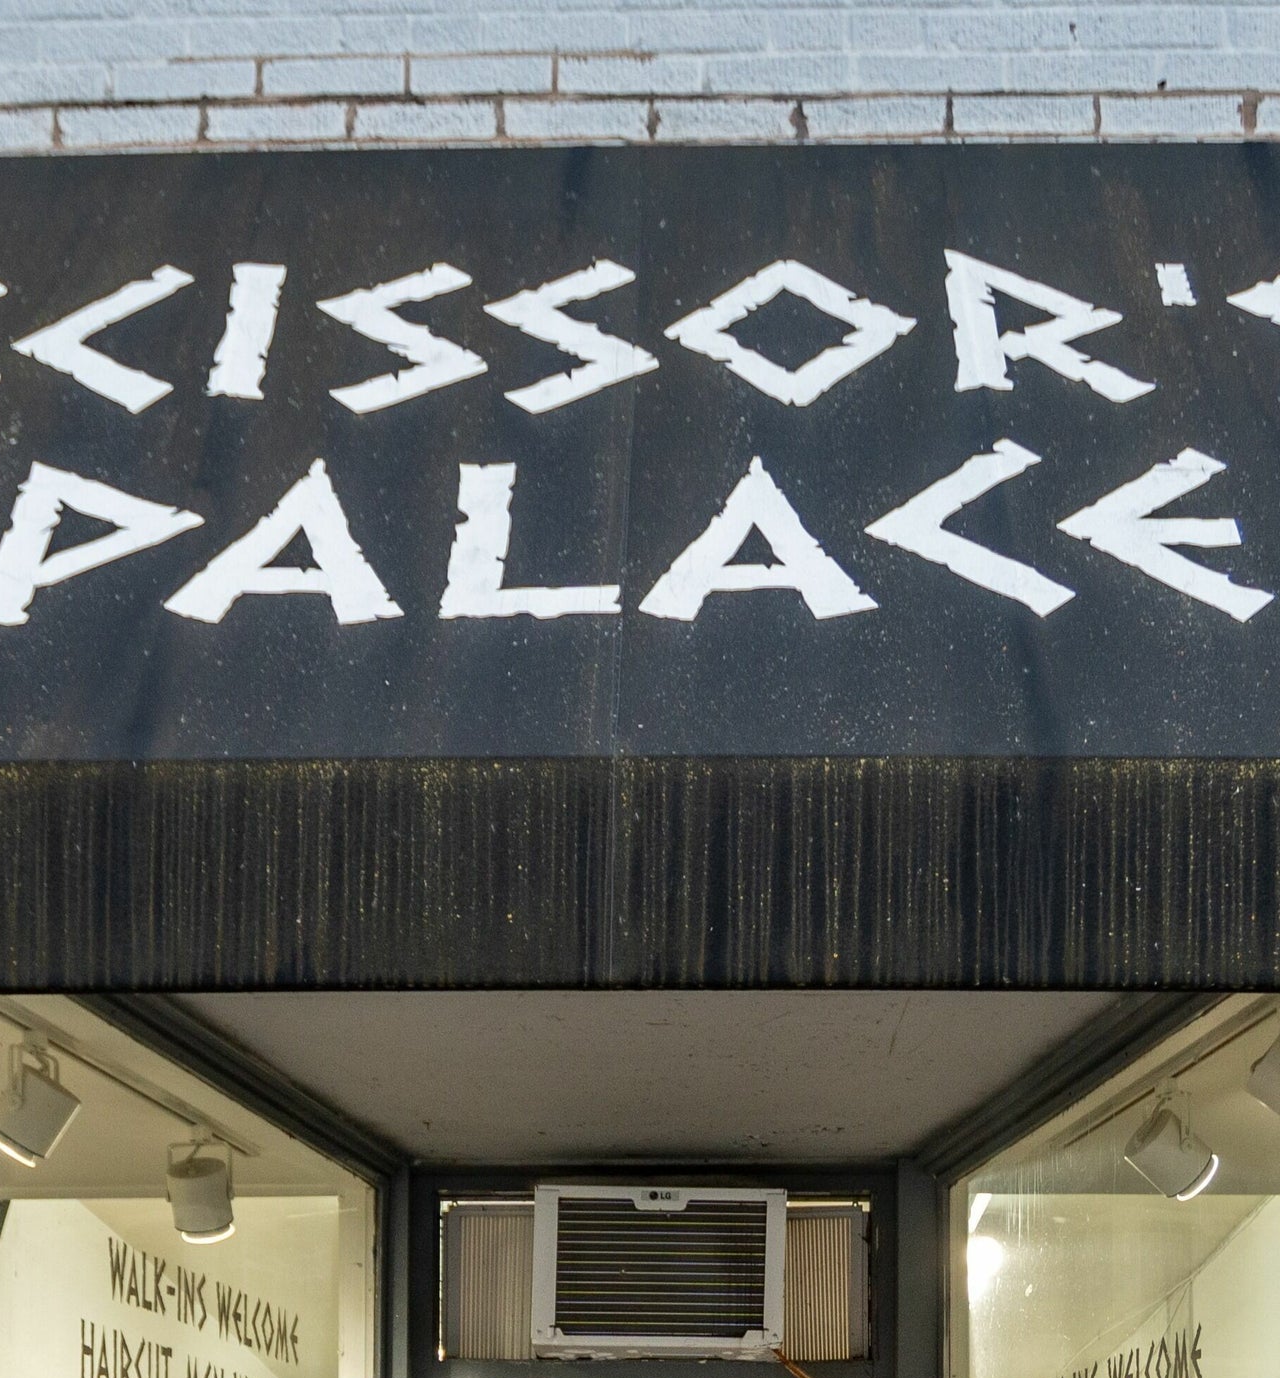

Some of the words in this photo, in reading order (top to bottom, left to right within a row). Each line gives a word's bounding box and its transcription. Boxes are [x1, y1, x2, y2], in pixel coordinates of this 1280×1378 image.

[660, 1191, 672, 1200] LG
[108, 1237, 207, 1332] WALK-INS
[216, 1281, 299, 1365] WELCOME
